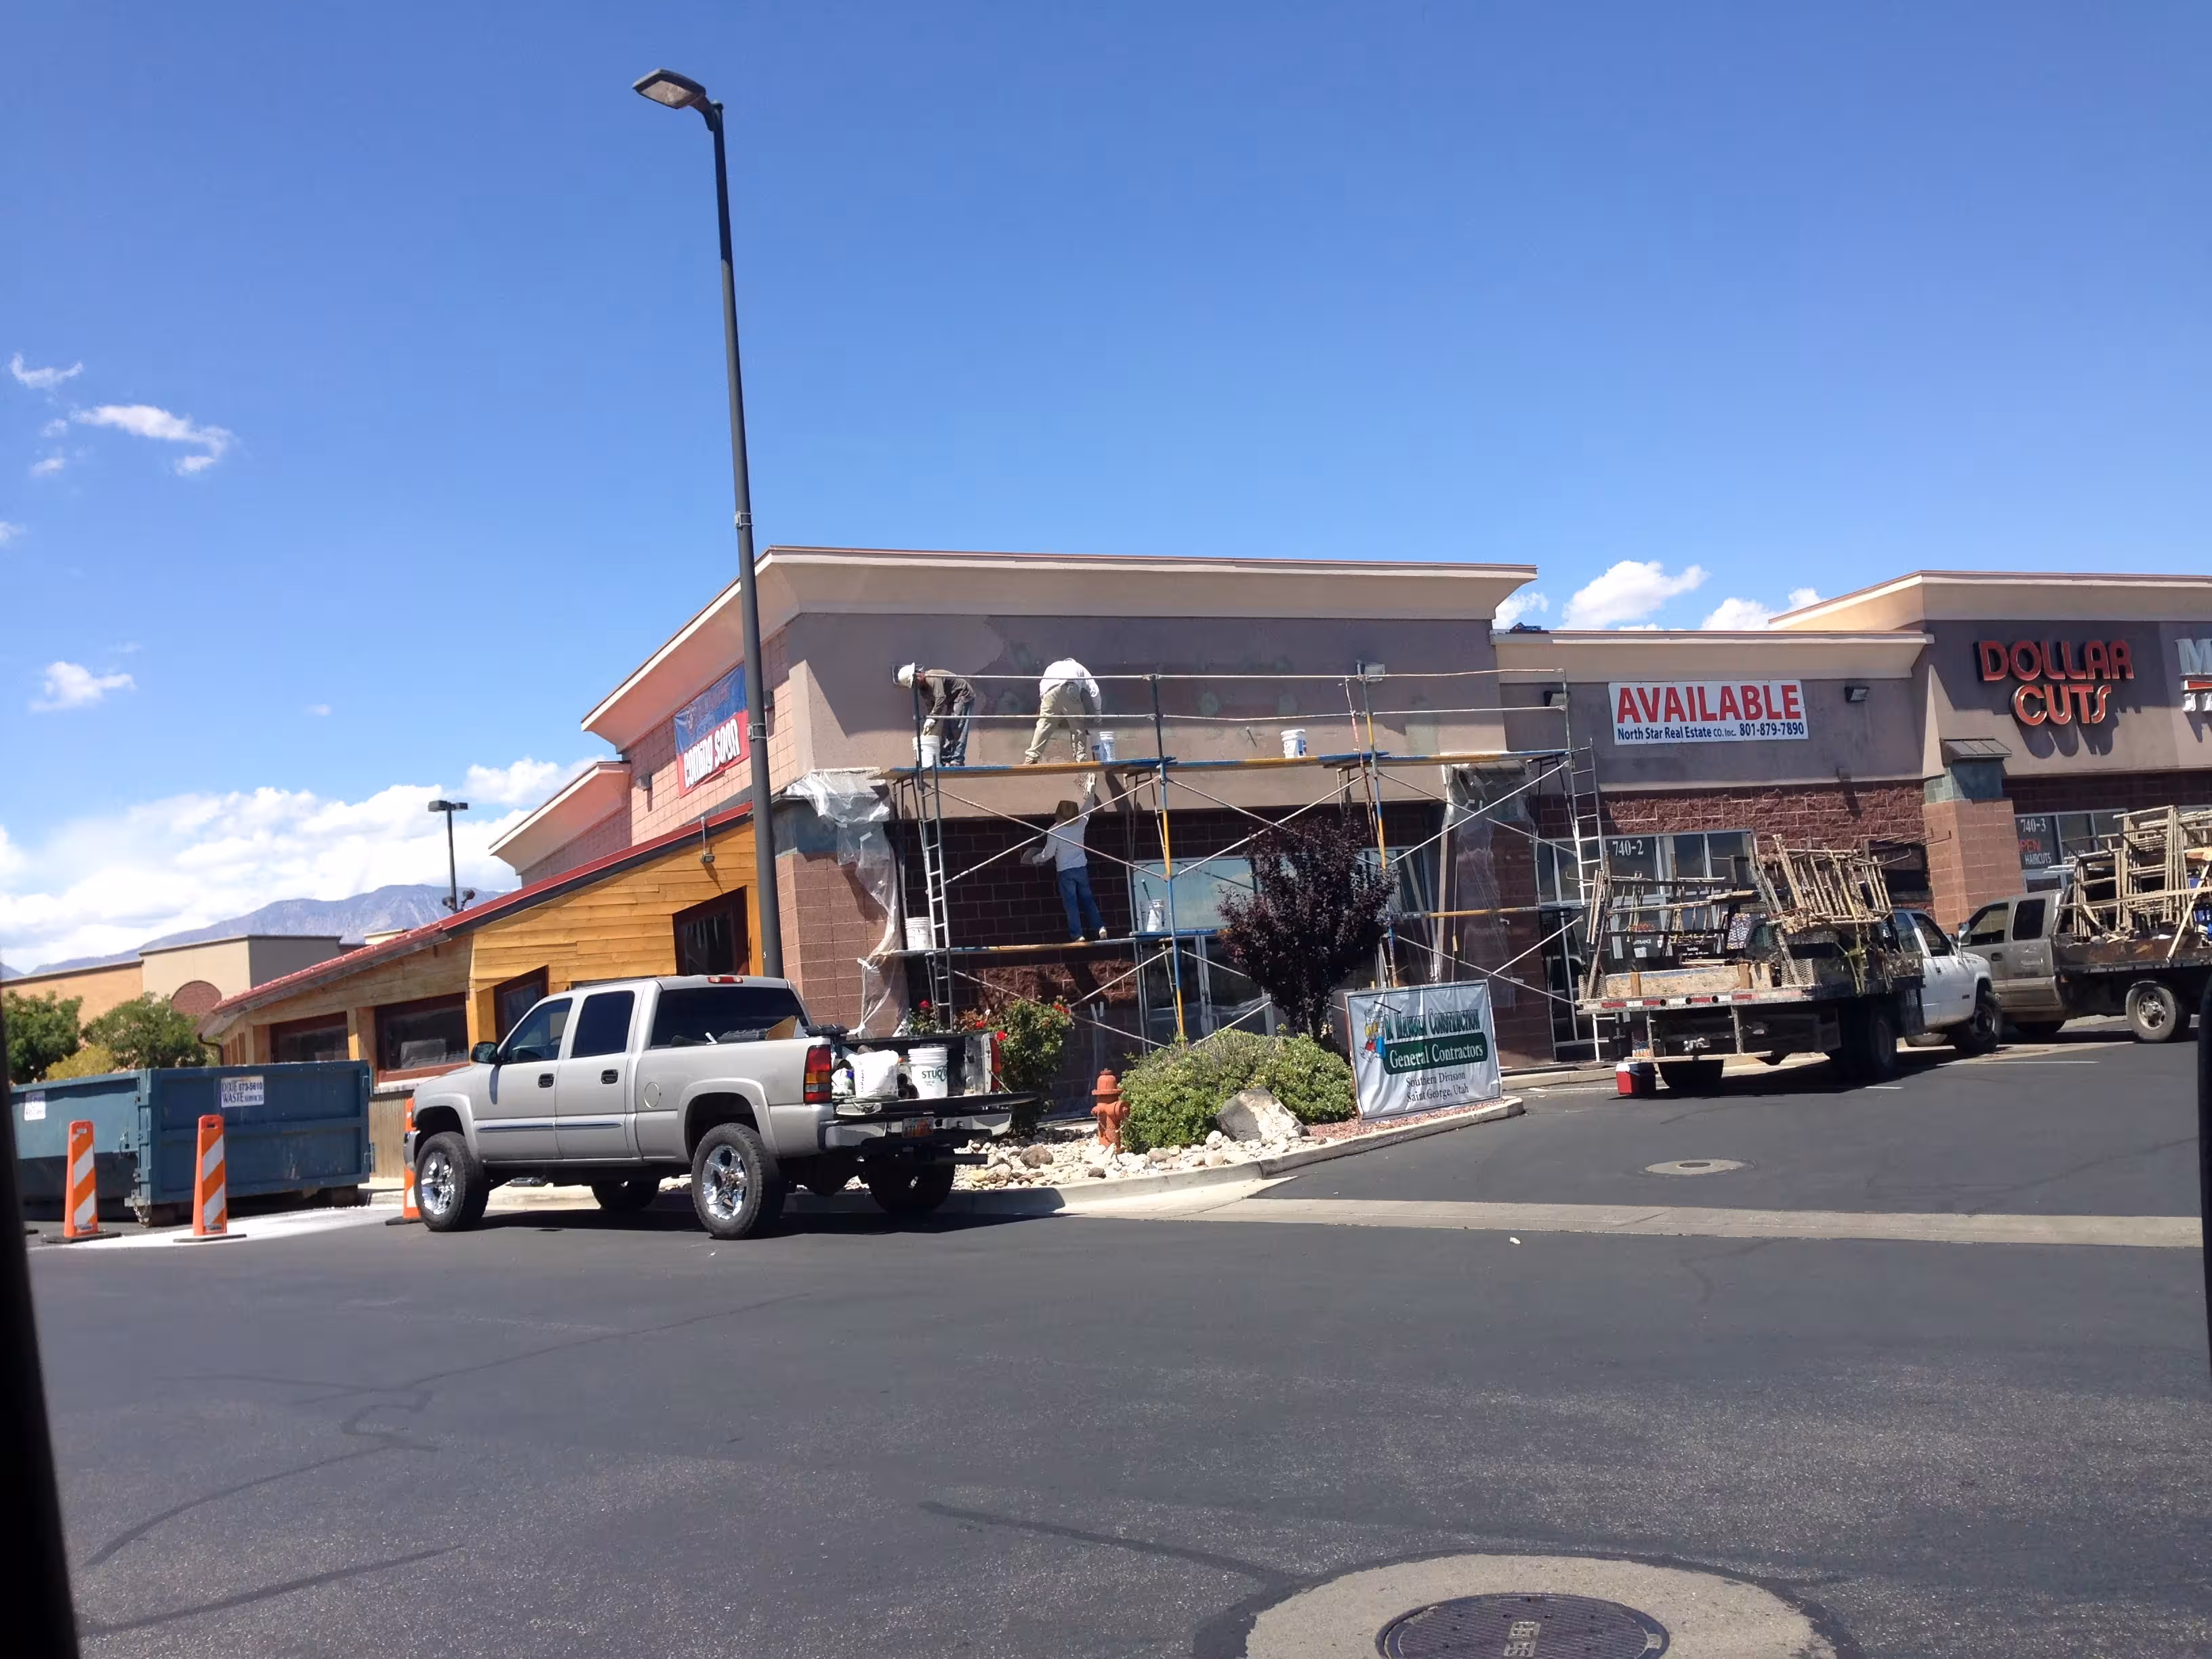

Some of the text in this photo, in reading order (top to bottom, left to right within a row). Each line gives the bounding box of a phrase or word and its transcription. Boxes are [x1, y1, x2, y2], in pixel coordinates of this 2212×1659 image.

[1978, 639, 2134, 681] DOLLAR
[1617, 684, 1802, 724] AVAILABLE
[2013, 683, 2111, 726] CUTS
[1617, 727, 1643, 740] North
[1645, 726, 1662, 739] Star
[1664, 726, 1684, 739] Real
[1685, 725, 1712, 738] Estate
[1740, 722, 1805, 737] 801-879-7890
[2020, 817, 2047, 833] 740-3
[1612, 839, 1644, 857] 740-2
[2019, 839, 2041, 852] PEN
[2024, 852, 2052, 865] HAIRCUTS
[1389, 1043, 1483, 1069] General Contractors
[1406, 1071, 1466, 1088] Southern Division
[222, 1092, 244, 1103] WASTE
[1407, 1083, 1469, 1103] Saint George, Utah
